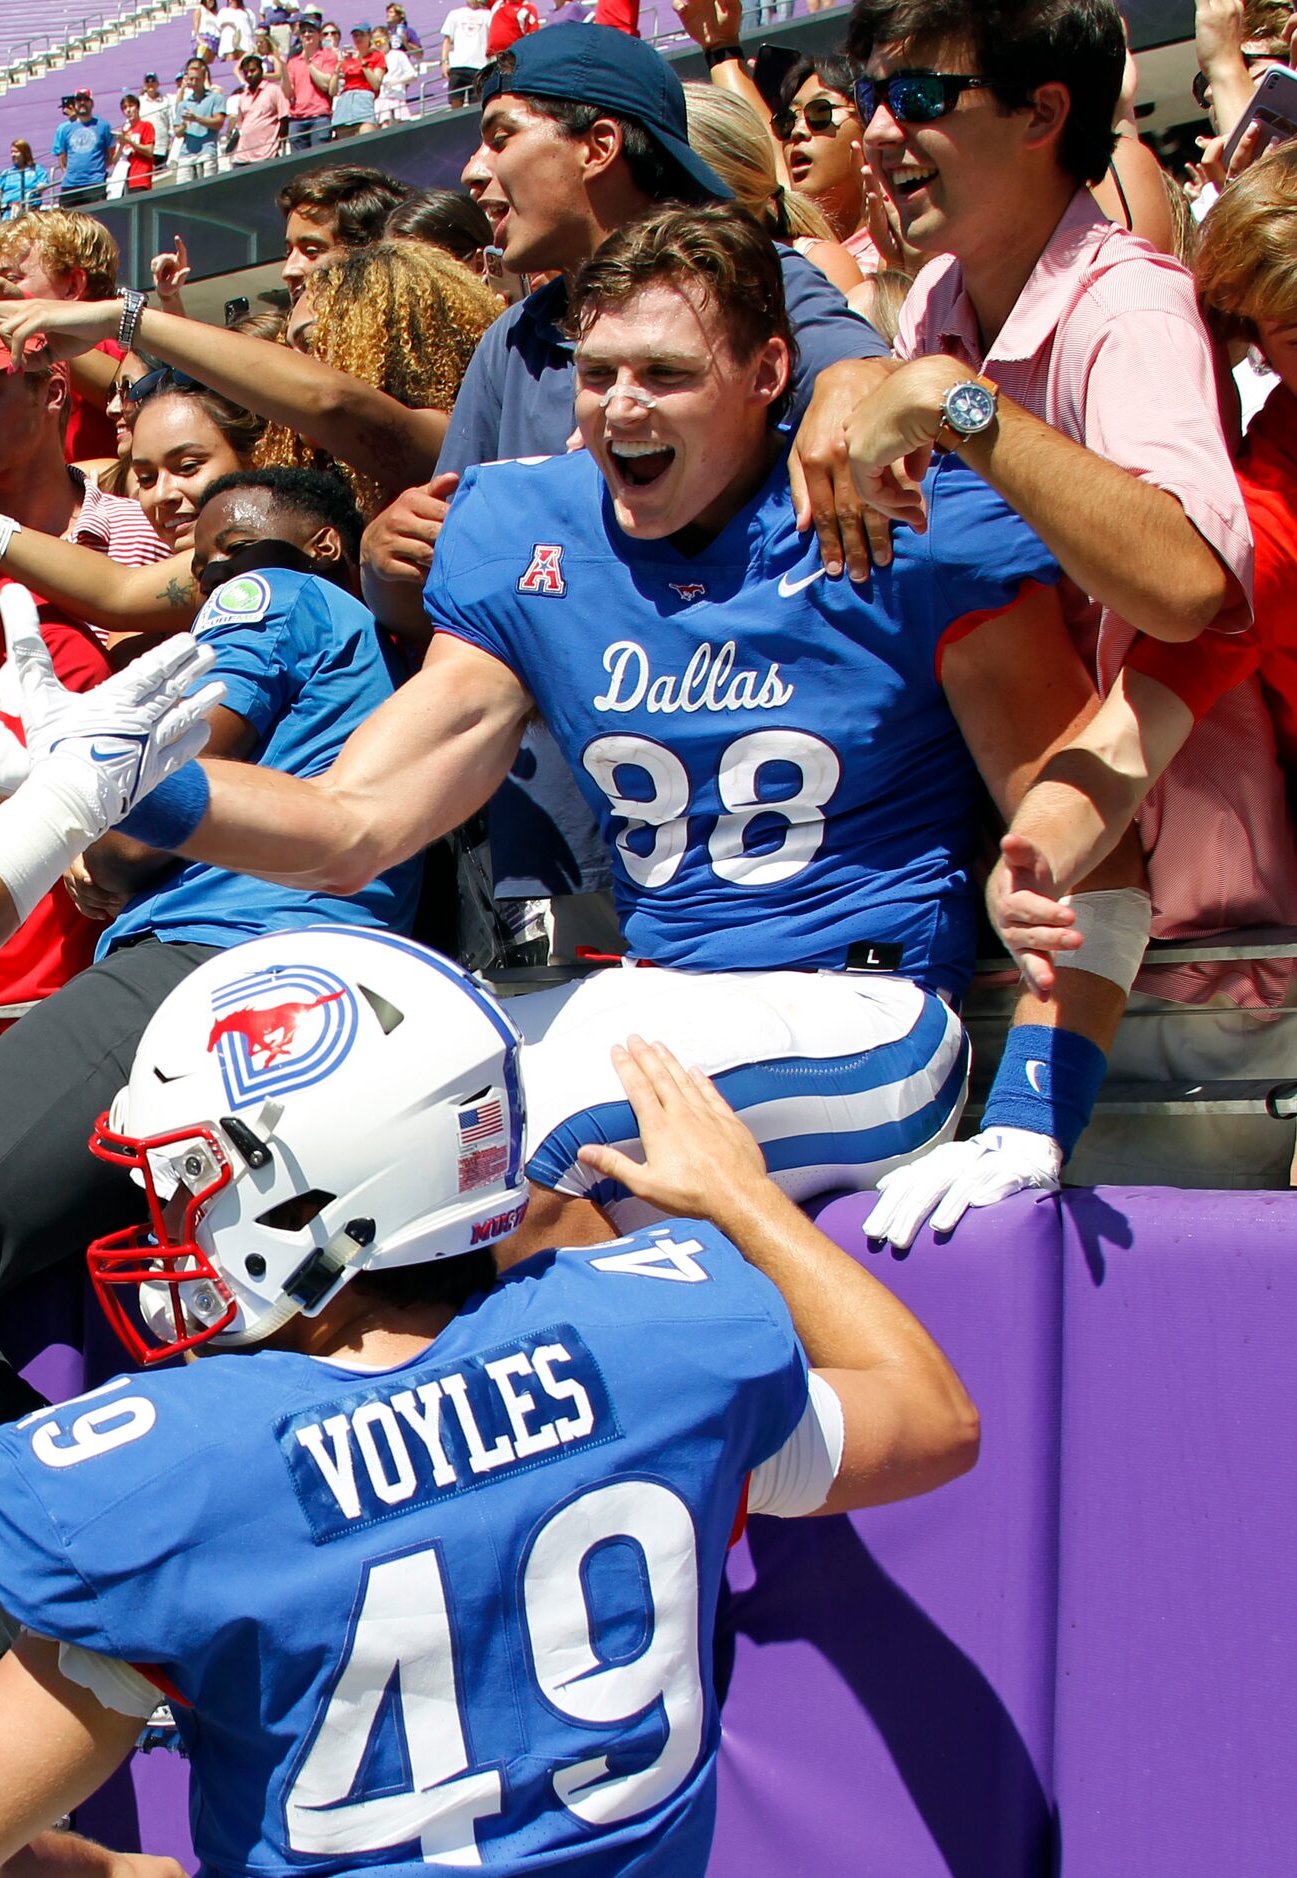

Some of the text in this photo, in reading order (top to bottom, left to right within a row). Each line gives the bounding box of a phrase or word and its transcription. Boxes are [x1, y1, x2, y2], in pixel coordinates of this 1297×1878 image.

[516, 542, 568, 598] A
[594, 640, 794, 713] Dallas
[582, 729, 841, 888] 88
[867, 949, 880, 964] L
[296, 1344, 594, 1519] VOYLES
[286, 1481, 703, 1866] 49
